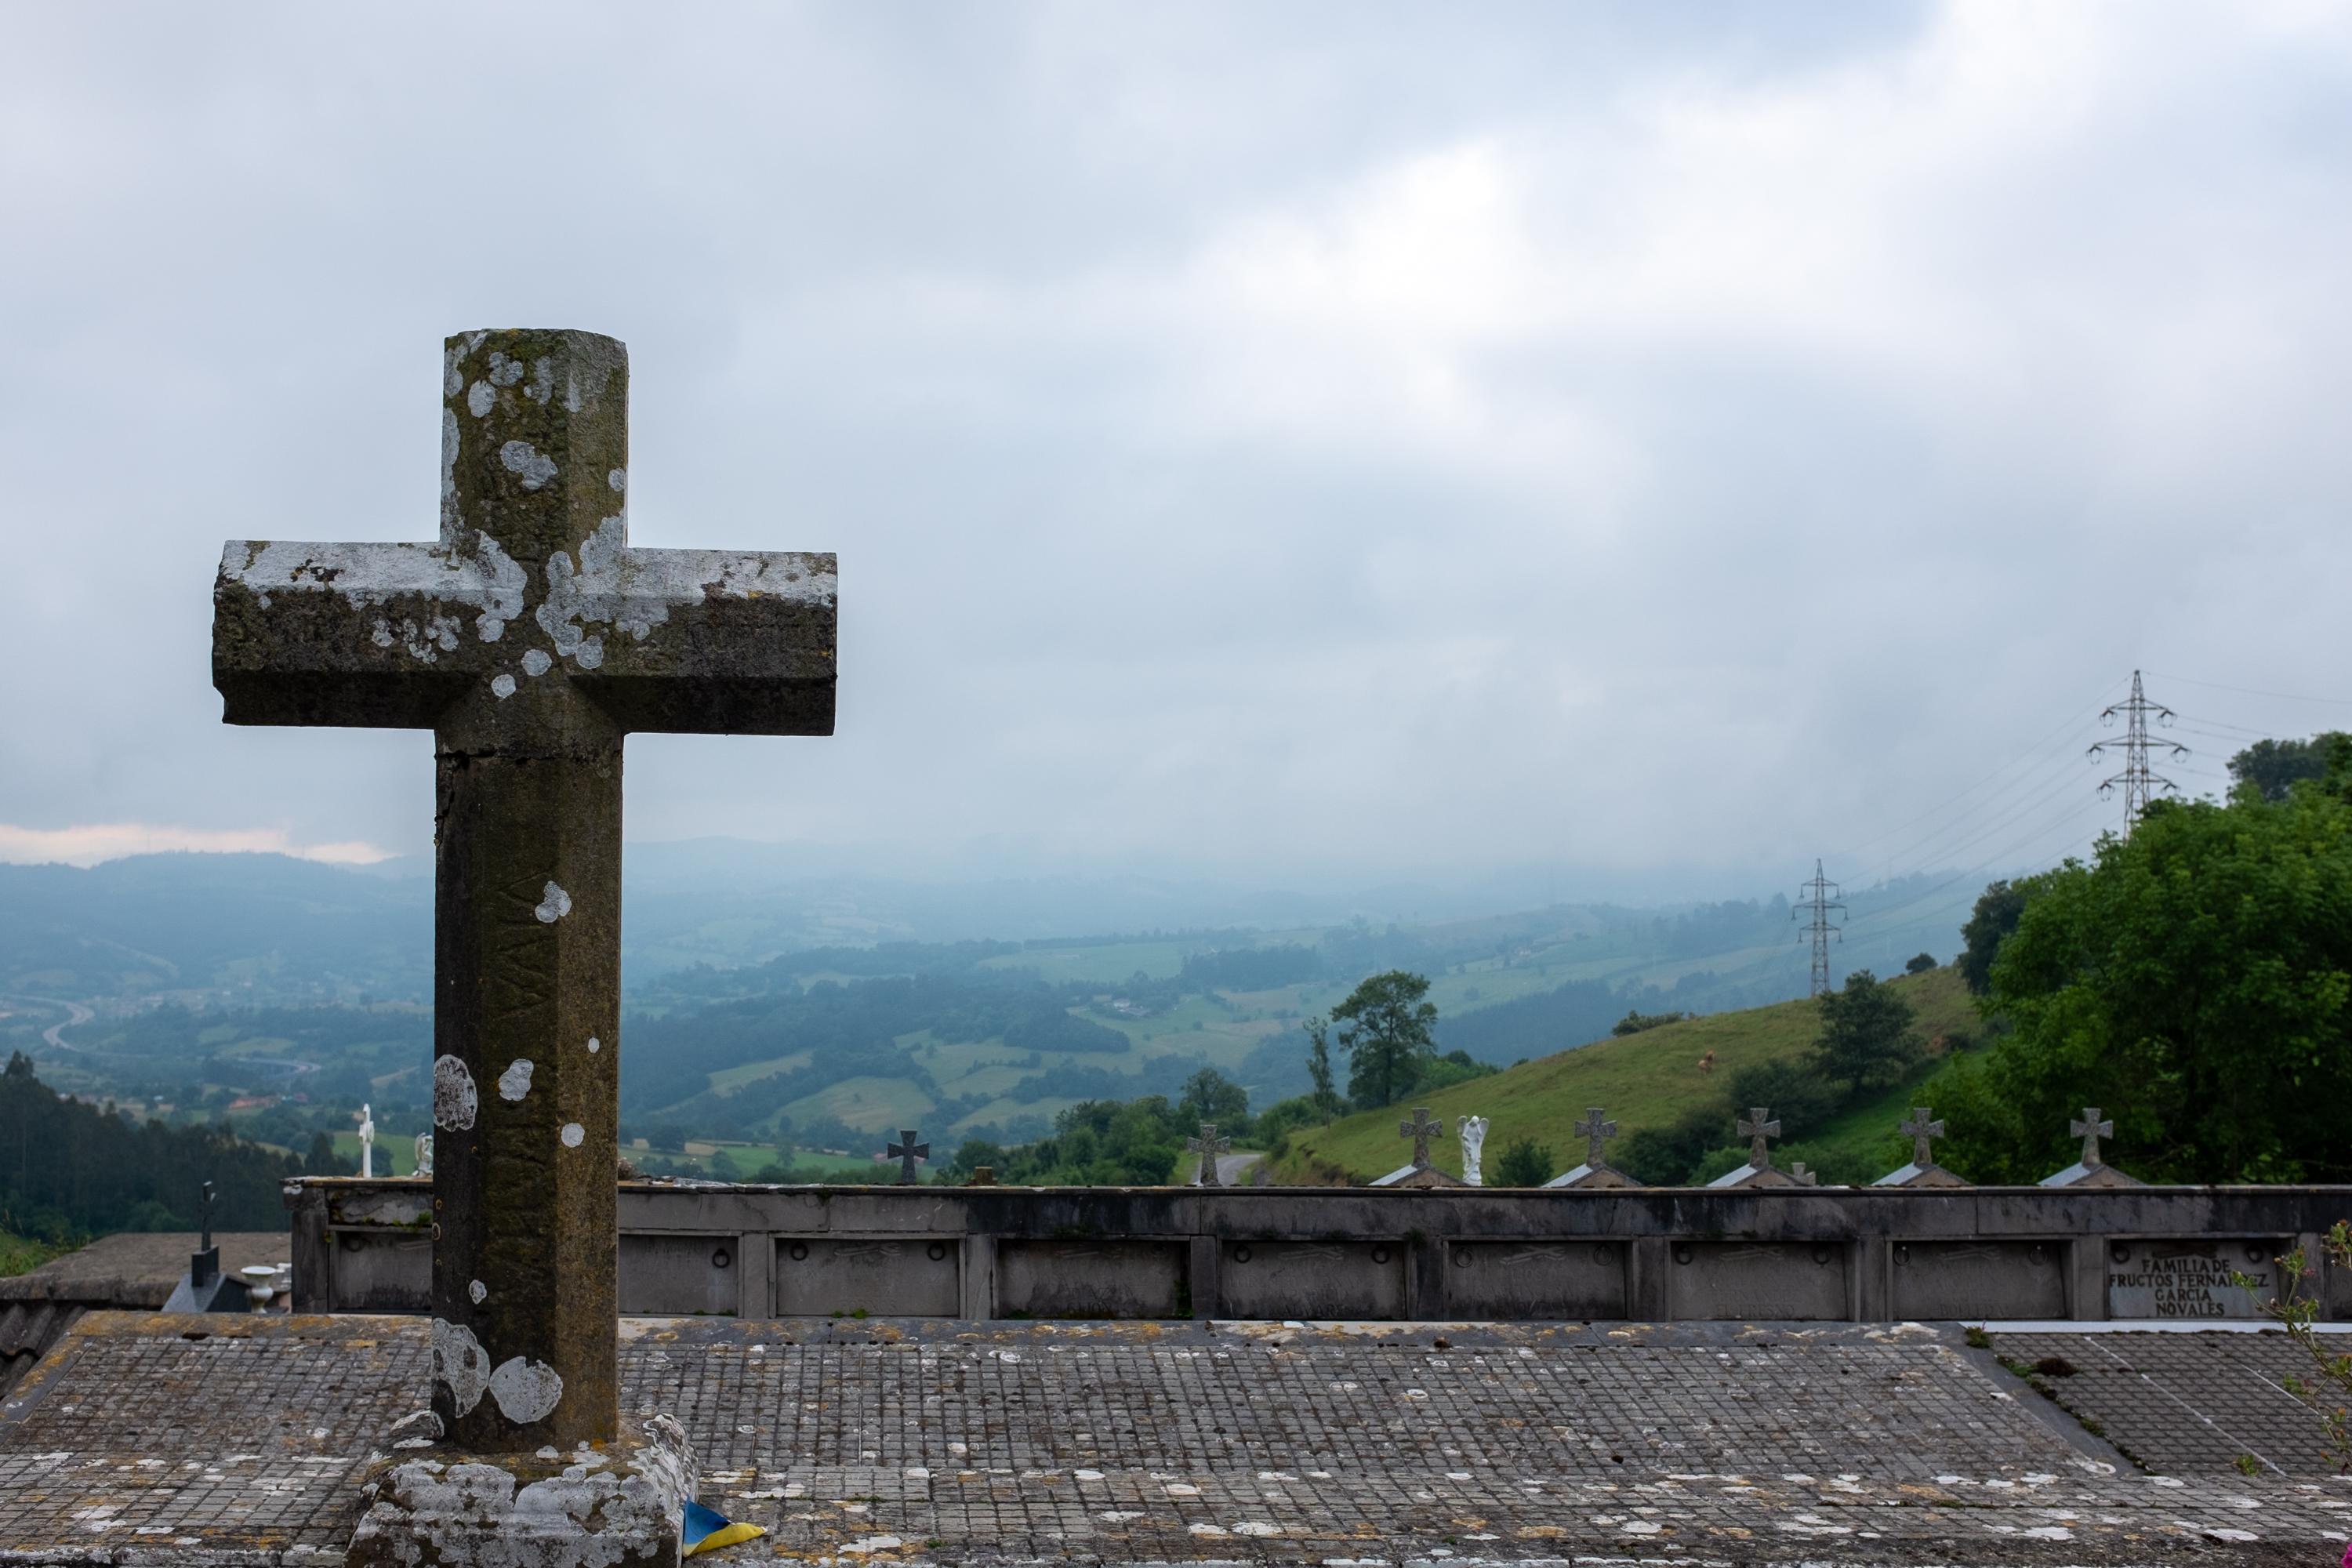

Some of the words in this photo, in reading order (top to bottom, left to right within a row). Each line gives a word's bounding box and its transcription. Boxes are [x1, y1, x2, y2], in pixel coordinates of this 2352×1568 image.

[2141, 1259, 2209, 1273] FAMILIA
[2212, 1259, 2230, 1273] DE
[2109, 1274, 2173, 1287] FRUCTOS
[2155, 1289, 2212, 1301] GARCIA
[2157, 1302, 2225, 1316] NOVALES
